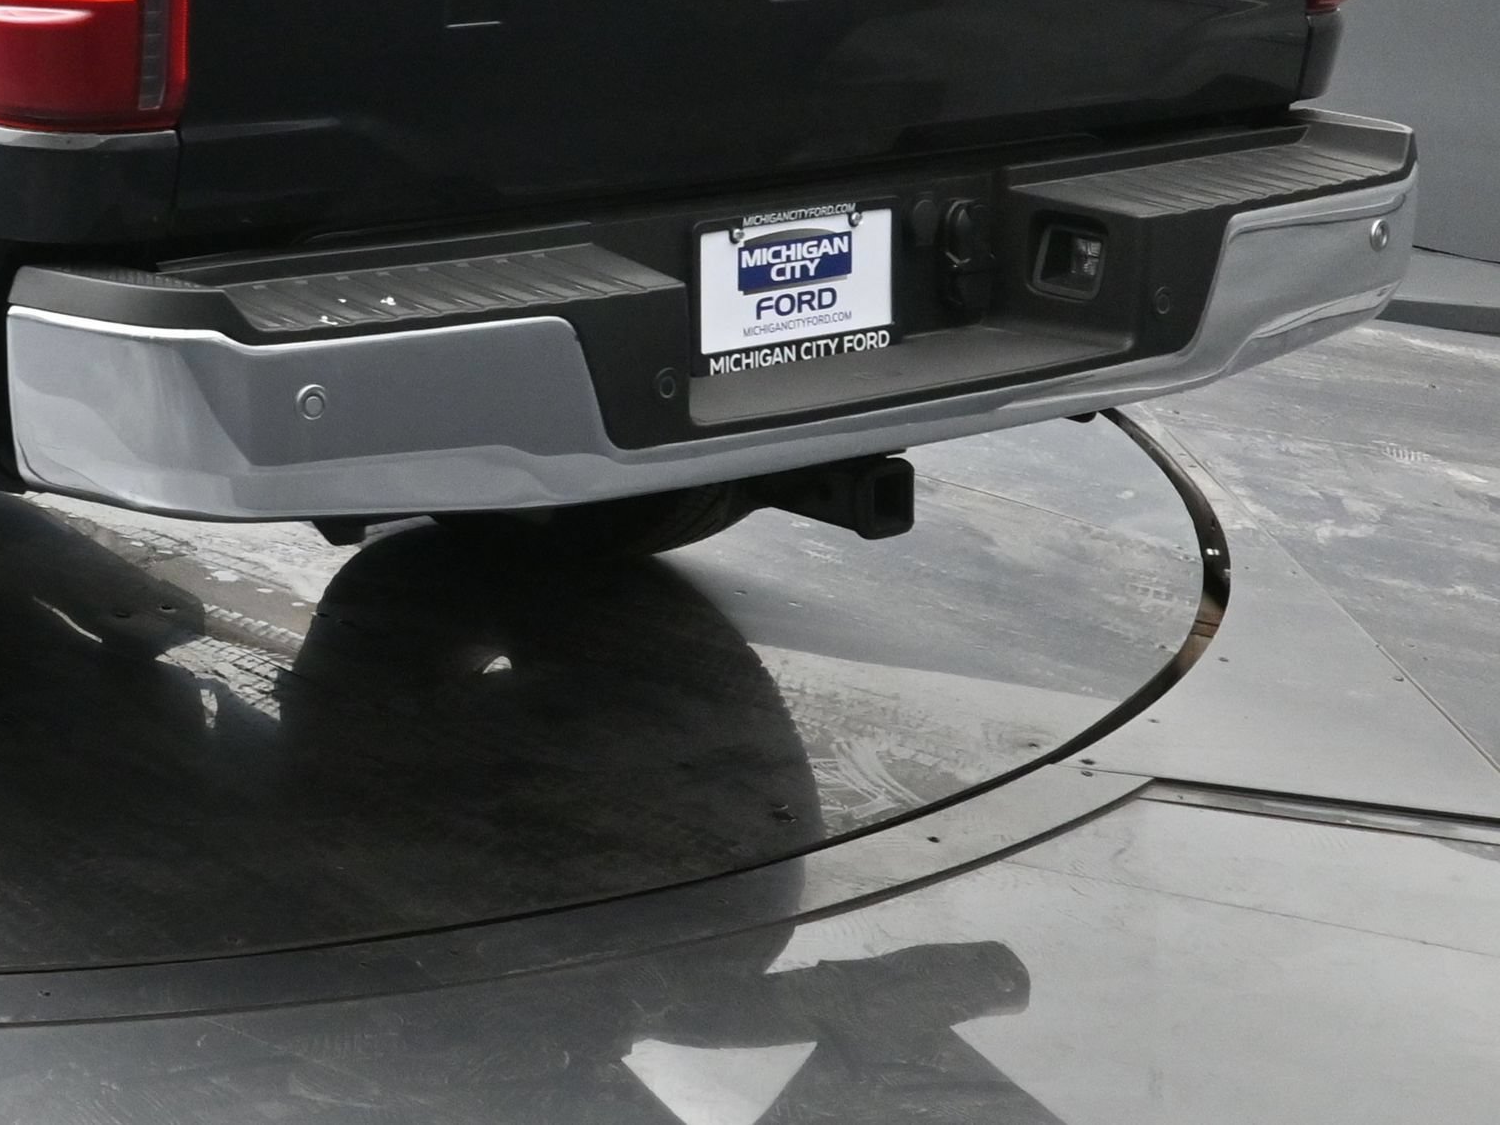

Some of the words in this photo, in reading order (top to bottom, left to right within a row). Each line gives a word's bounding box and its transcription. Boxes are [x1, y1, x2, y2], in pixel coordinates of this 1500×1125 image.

[742, 202, 856, 227] MICHIGANCITYFORD.COM
[741, 236, 850, 268] MICHIGAN
[770, 258, 821, 282] CITY
[756, 287, 838, 321] FORD
[742, 310, 853, 338] MICHIGANCITYFORD.COM
[709, 345, 797, 376] MICHIGAN
[800, 337, 840, 361] CITY
[843, 329, 891, 354] FORD
